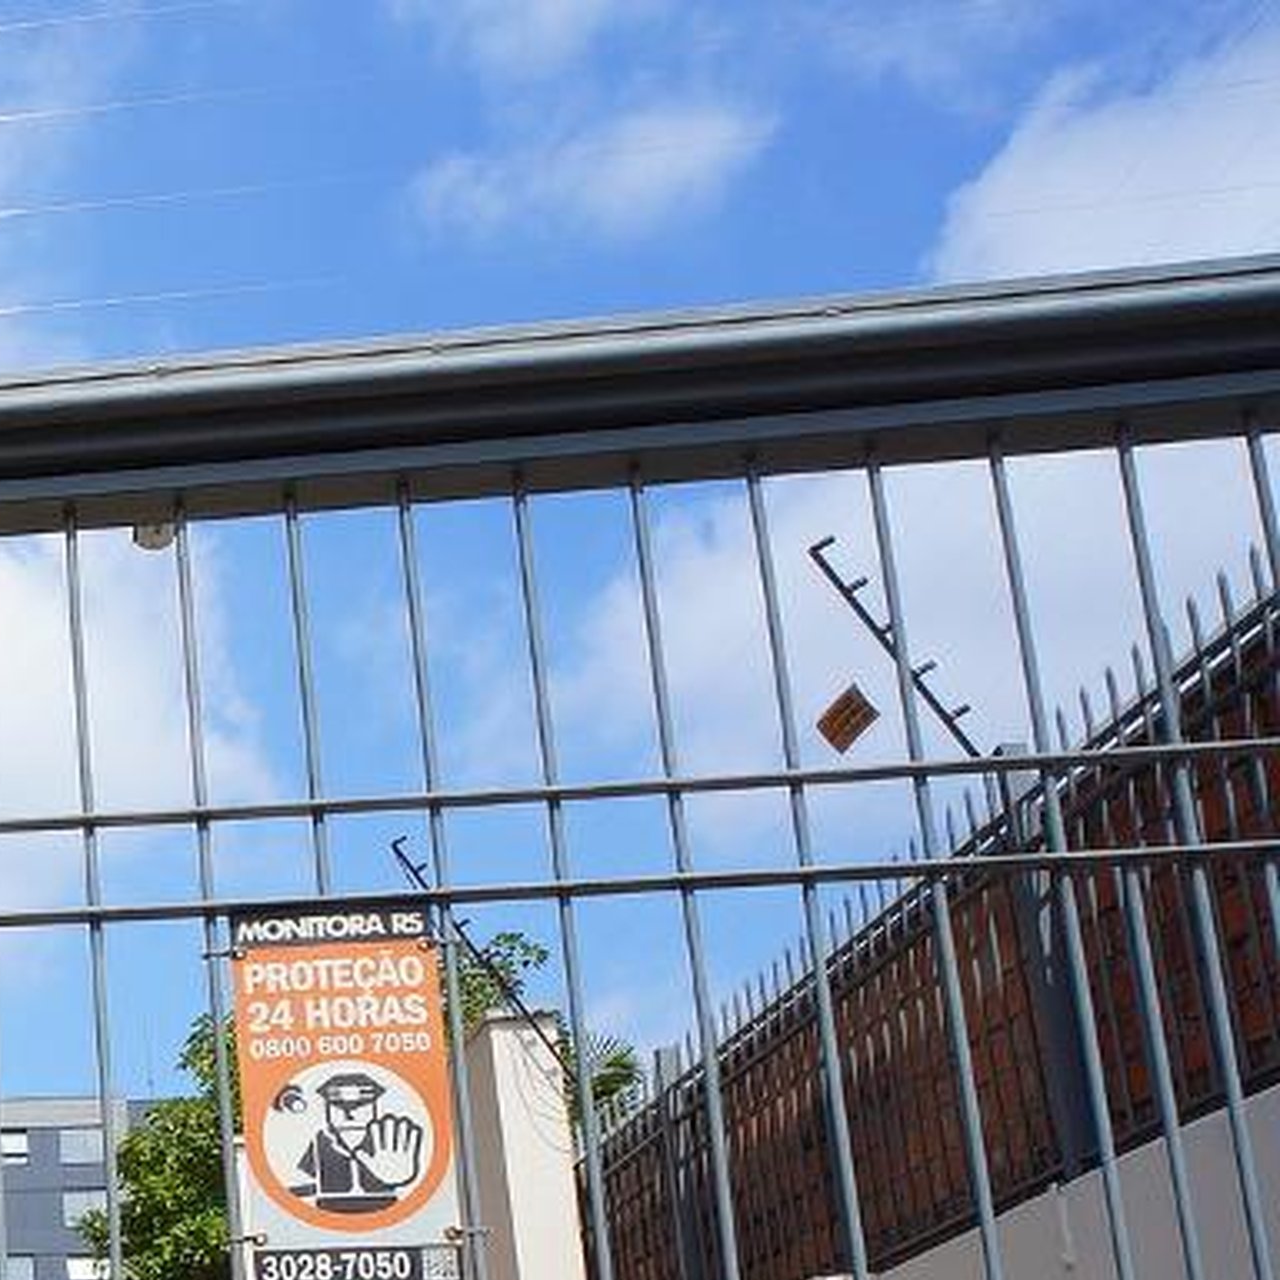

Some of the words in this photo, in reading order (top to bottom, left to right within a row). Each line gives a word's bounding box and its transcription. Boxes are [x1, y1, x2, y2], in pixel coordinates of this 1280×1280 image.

[238, 914, 385, 941] MONITORA
[392, 911, 424, 935] RS
[244, 950, 425, 994] PROTEÇÃO
[248, 1003, 295, 1033] 24
[307, 994, 428, 1030] HORAS
[250, 1037, 312, 1058] 0800
[319, 1034, 366, 1055] 600
[373, 1032, 432, 1054] 7050
